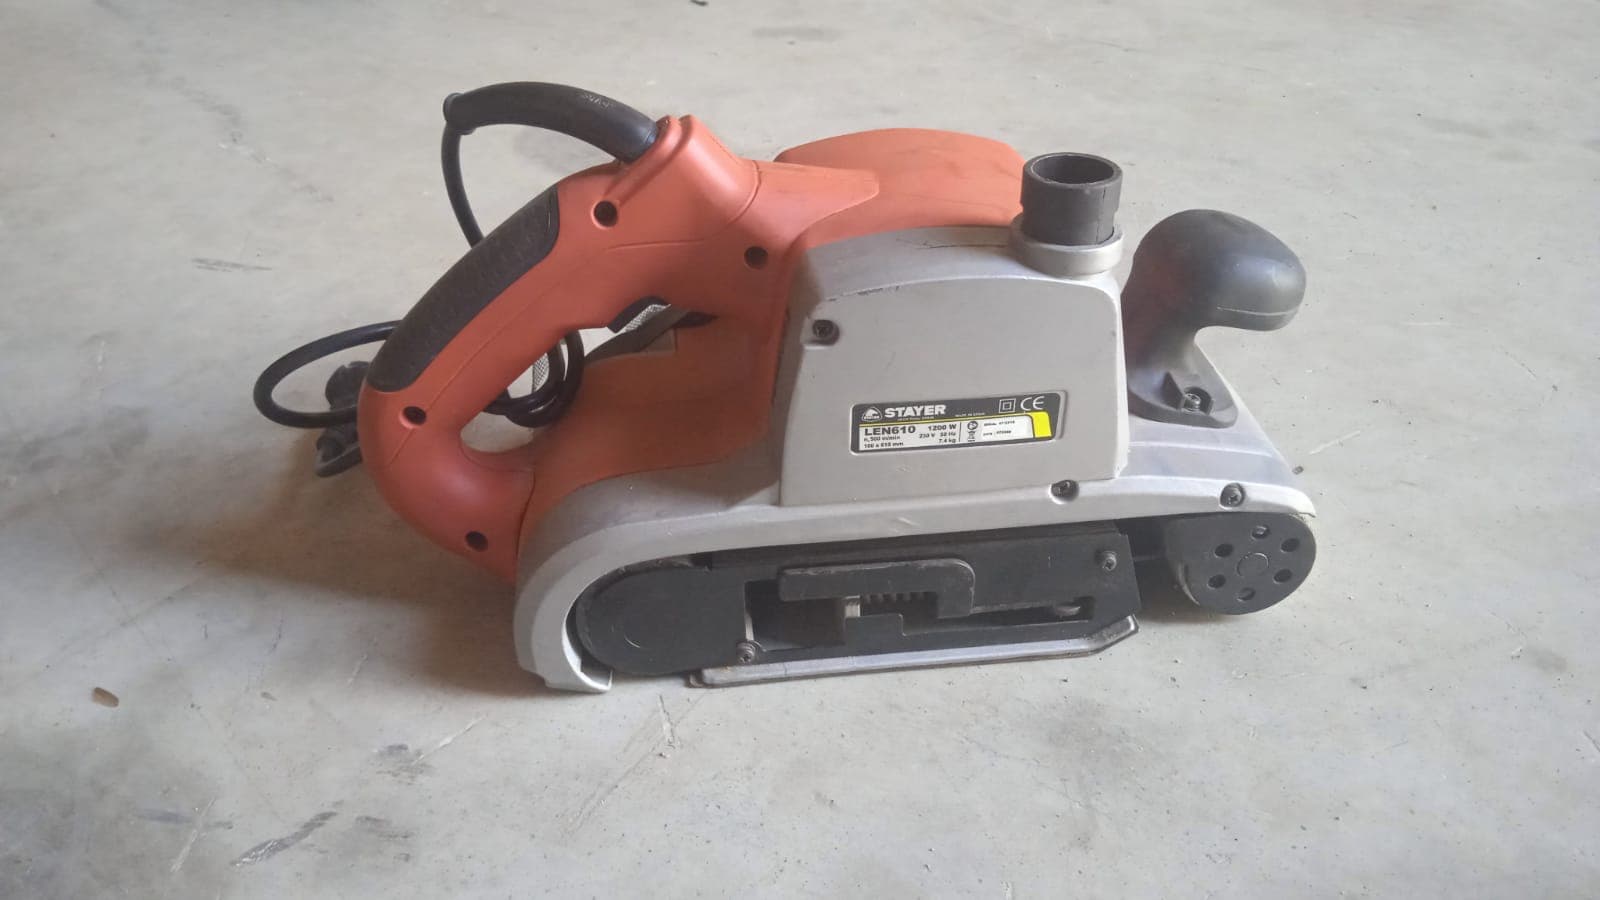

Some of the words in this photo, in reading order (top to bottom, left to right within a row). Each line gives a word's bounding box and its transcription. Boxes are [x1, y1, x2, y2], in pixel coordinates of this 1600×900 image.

[1020, 396, 1045, 411] CE
[884, 404, 946, 418] STAYER
[864, 425, 916, 436] LEN610
